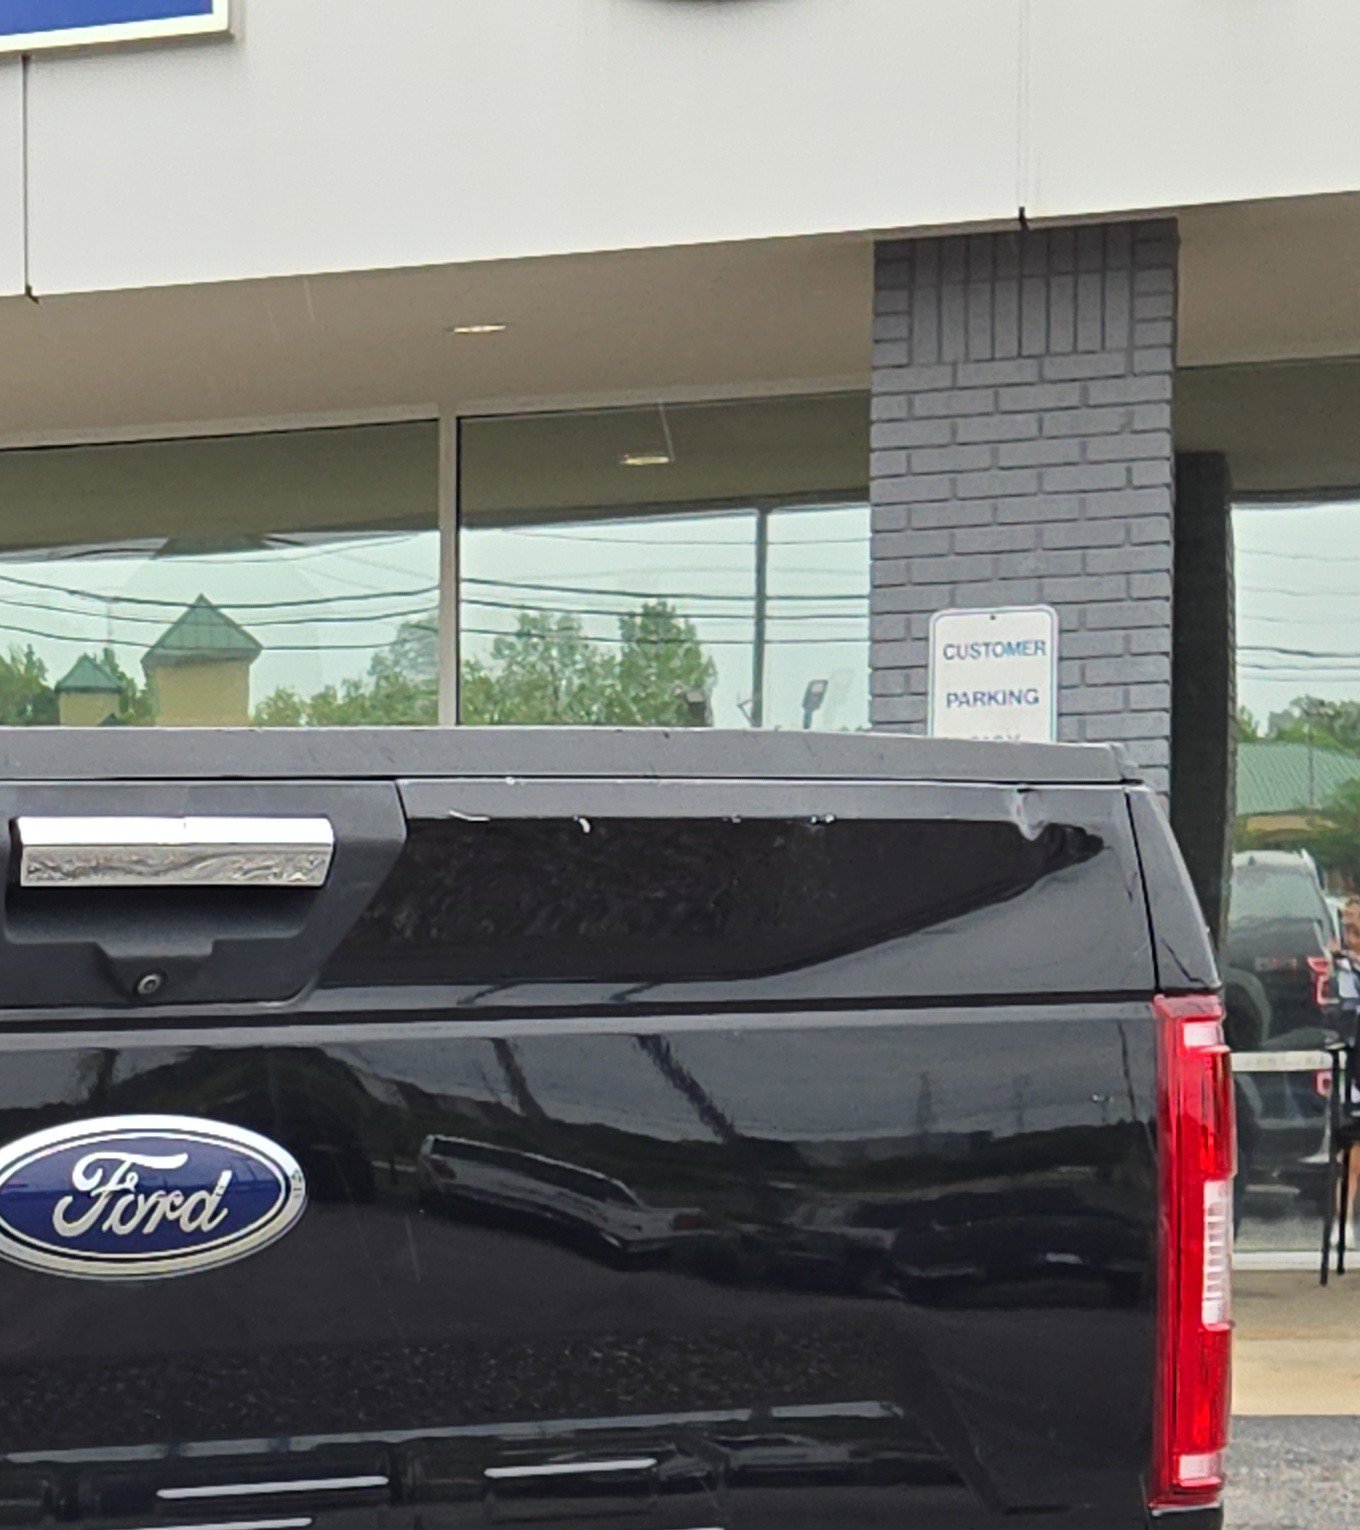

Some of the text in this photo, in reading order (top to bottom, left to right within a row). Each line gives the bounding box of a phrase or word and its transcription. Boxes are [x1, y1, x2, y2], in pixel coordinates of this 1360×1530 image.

[943, 639, 1047, 661] CUSTOMER
[946, 688, 1040, 709] PARKING
[52, 1151, 233, 1238] Ford
